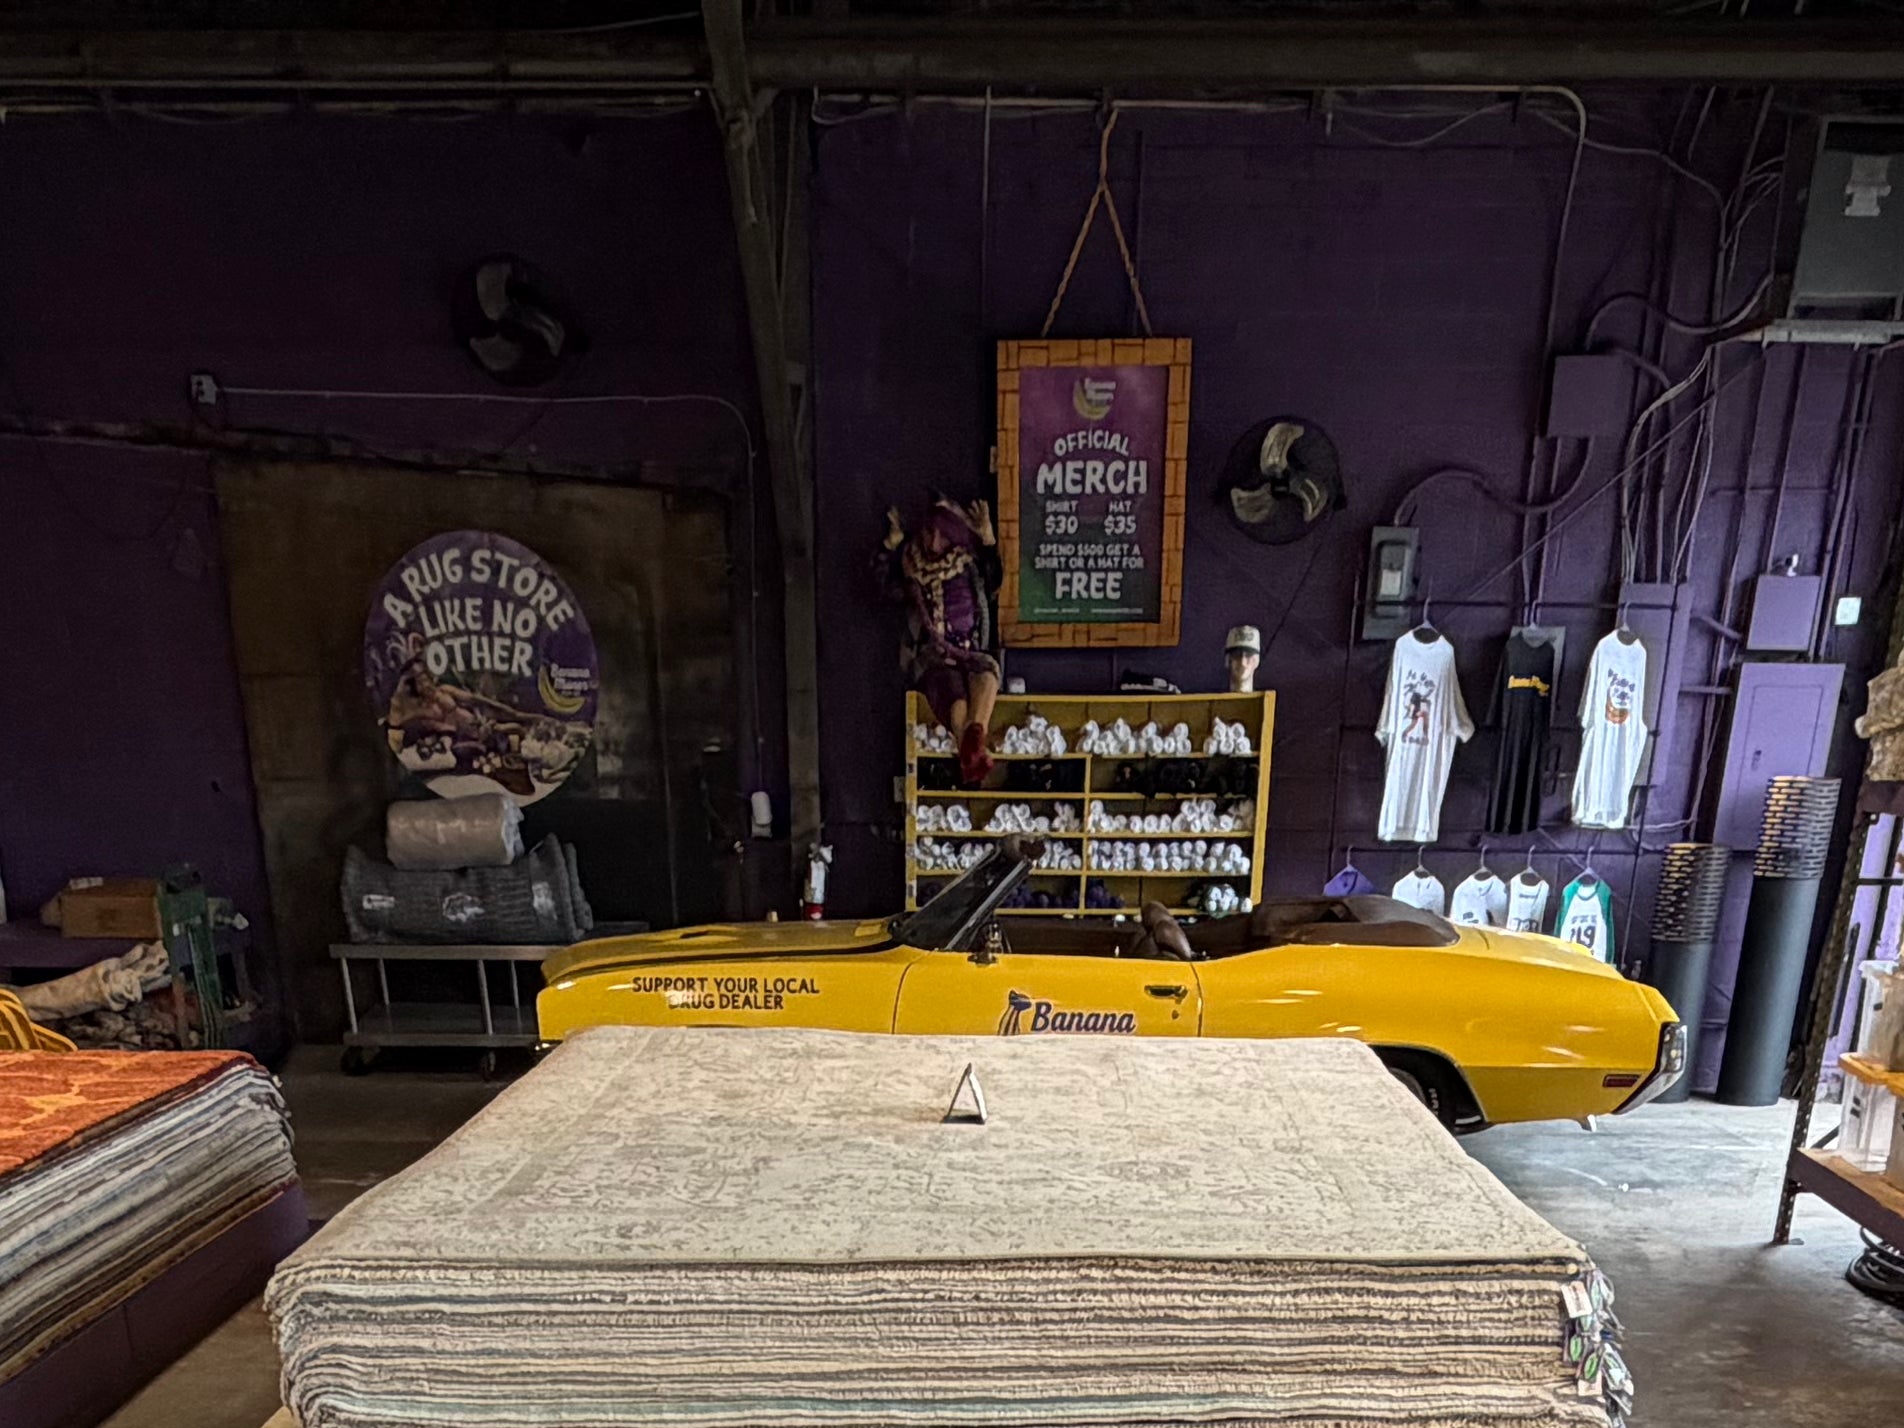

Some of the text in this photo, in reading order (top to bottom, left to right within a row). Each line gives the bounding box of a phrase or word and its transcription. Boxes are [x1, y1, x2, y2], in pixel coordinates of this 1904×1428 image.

[1054, 429, 1129, 456] OFFICIAL
[1036, 460, 1147, 494] MERCH
[1046, 501, 1132, 513] SHIRT HAT
[1045, 515, 1136, 535] $30 $35
[1034, 557, 1144, 569] SHIRT OR A HAT FOR
[1039, 544, 1075, 556] SPEND
[1106, 544, 1128, 556] GET
[1131, 544, 1140, 556] A
[384, 548, 575, 631] A RUG STORE
[1055, 572, 1123, 599] FREE
[418, 597, 537, 638] LIKE NO
[426, 635, 533, 677] OTHER
[632, 977, 820, 994] SUPPORT YOUR LOCAL
[719, 994, 784, 1010] DEALER
[1031, 1001, 1136, 1033] Banana
